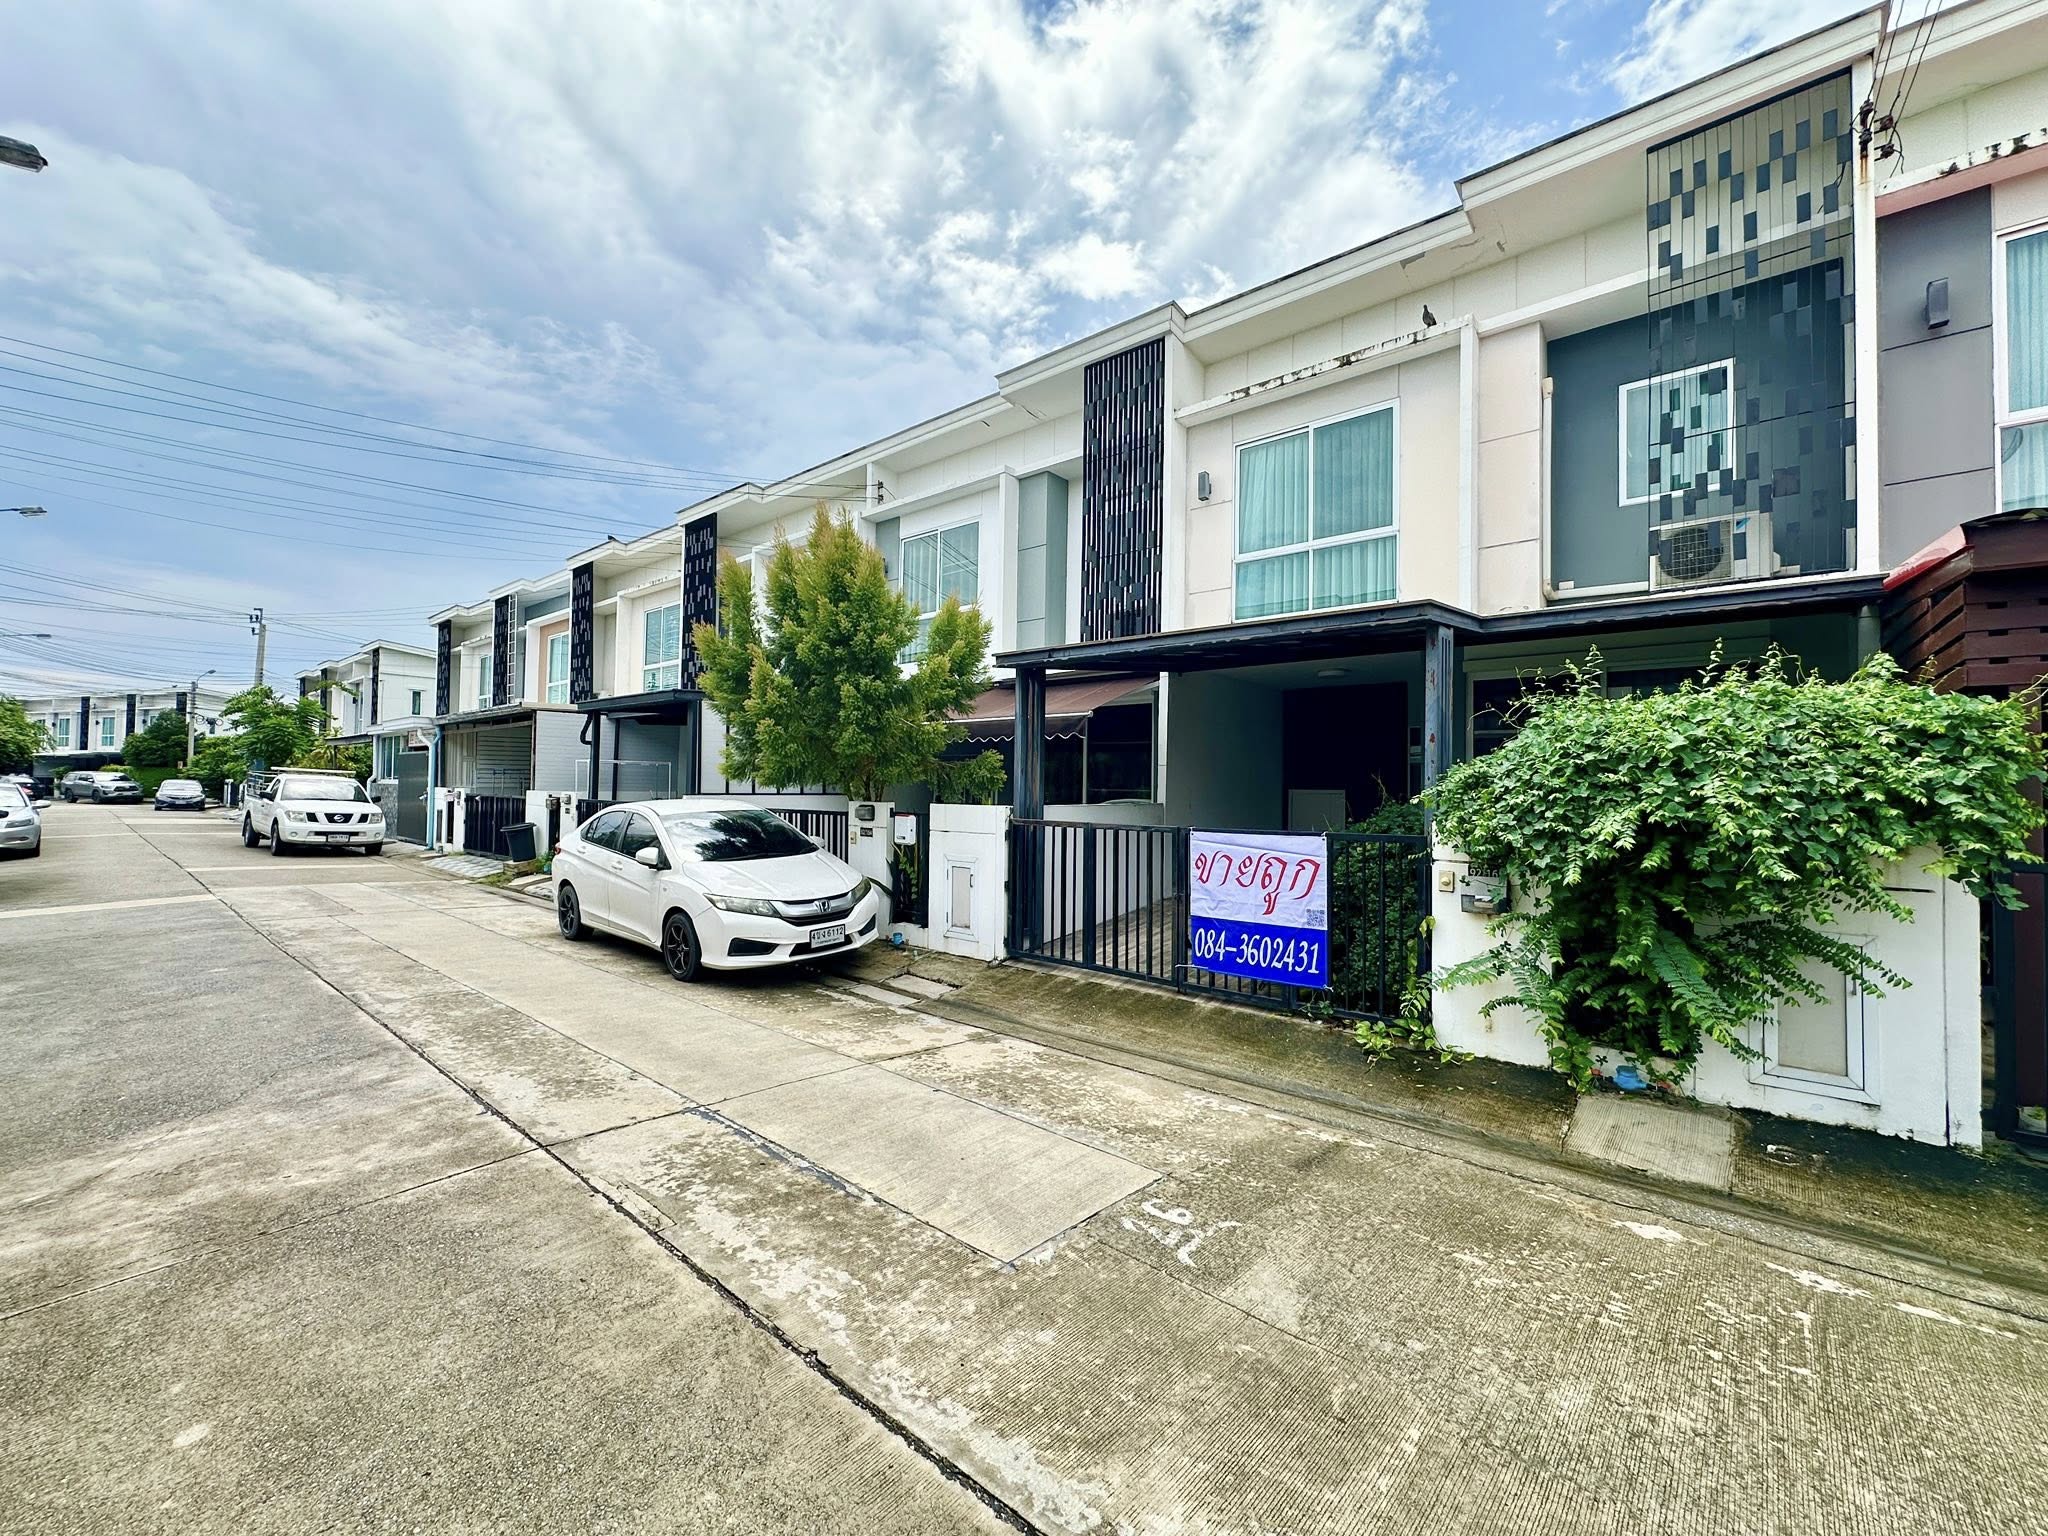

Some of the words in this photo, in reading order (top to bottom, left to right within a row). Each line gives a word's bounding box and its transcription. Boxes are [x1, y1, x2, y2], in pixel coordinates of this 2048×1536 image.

[1195, 850, 1320, 915] ขายถูก
[1195, 928, 1319, 974] 084-3602431
